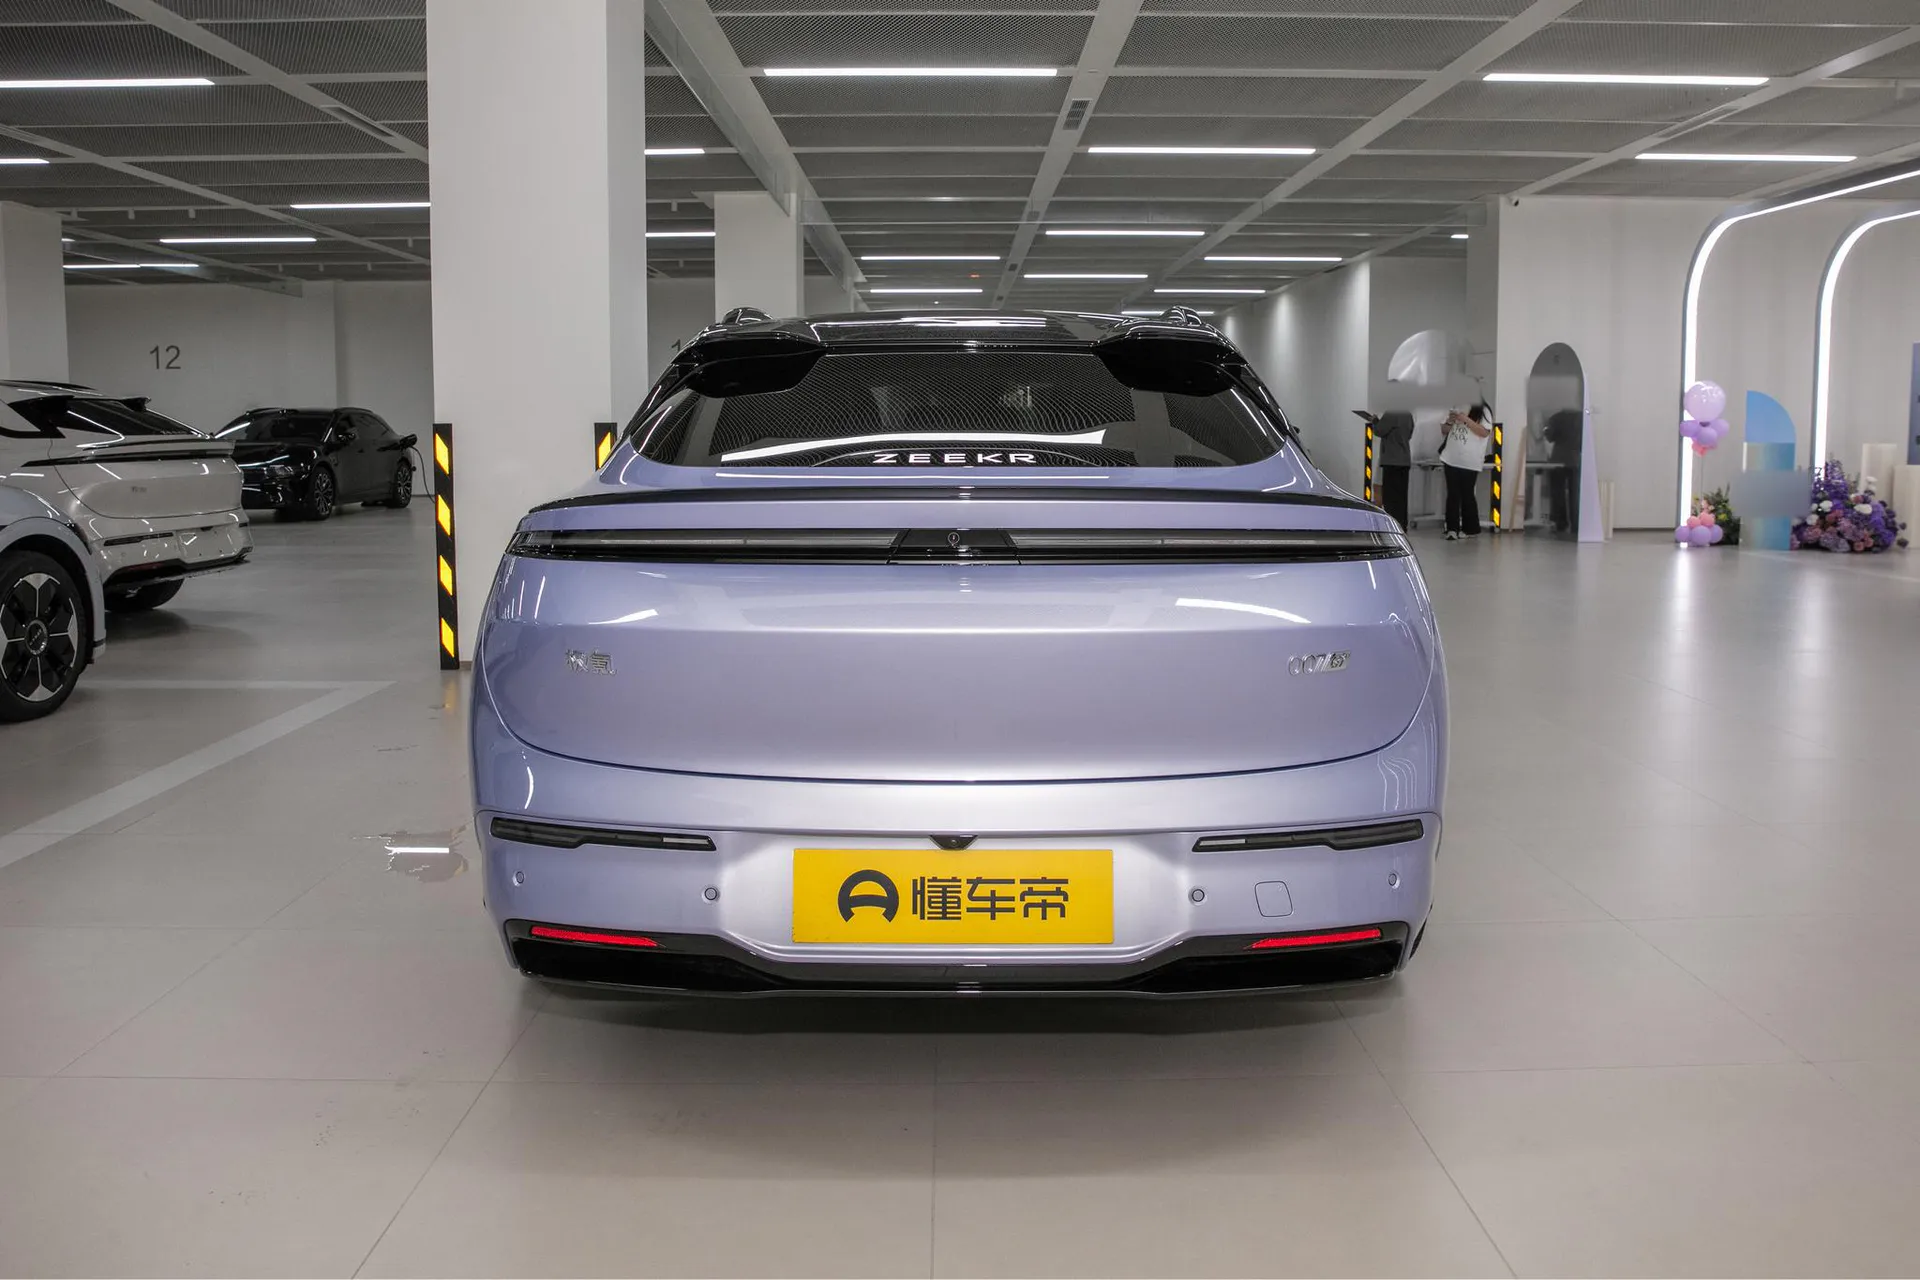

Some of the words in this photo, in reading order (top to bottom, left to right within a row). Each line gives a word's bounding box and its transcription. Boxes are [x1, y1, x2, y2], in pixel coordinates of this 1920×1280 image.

[150, 345, 181, 370] 12
[872, 453, 1037, 464] ZEEKR
[912, 877, 1069, 920] 懂车帝
